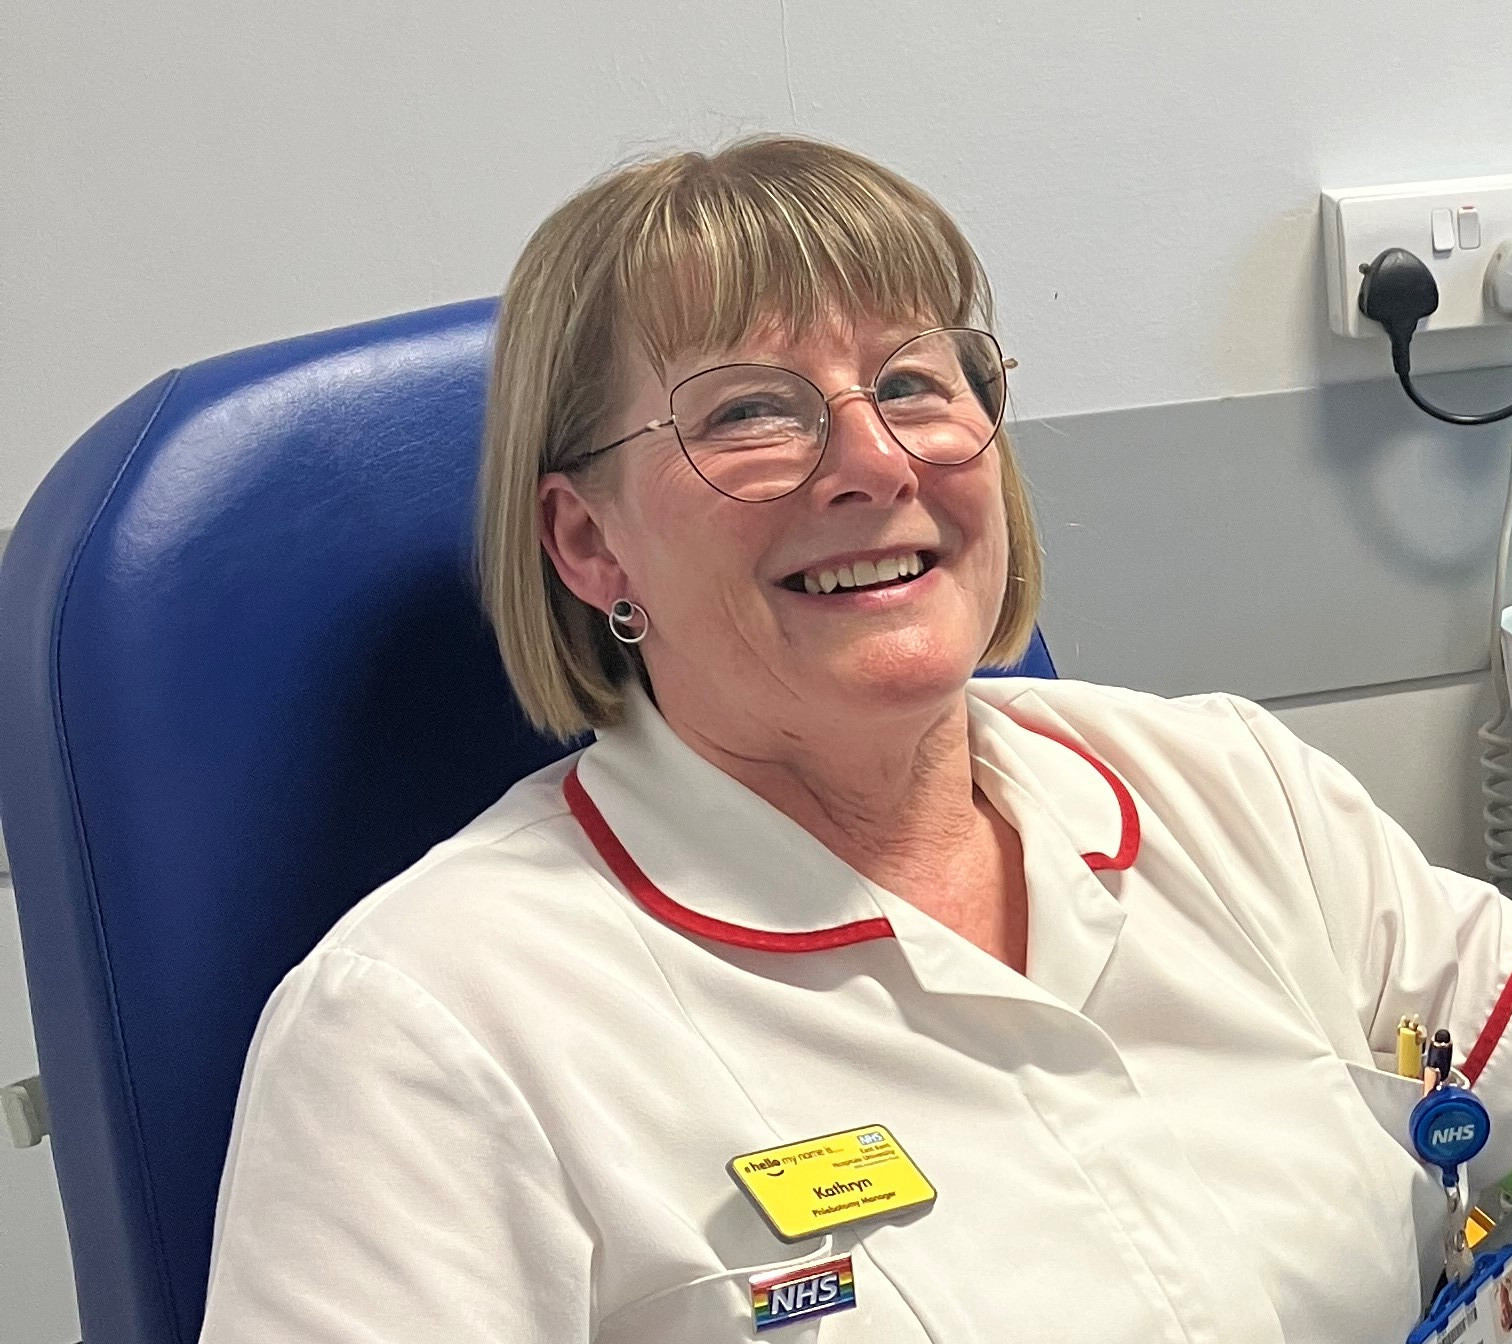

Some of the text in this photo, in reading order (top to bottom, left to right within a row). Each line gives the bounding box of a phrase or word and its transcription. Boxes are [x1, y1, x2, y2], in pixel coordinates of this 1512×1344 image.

[858, 1132, 884, 1144] NHS
[1432, 1124, 1475, 1146] NHS
[782, 1156, 798, 1165] my
[798, 1149, 824, 1161] name
[813, 1179, 873, 1199] Kathryn
[770, 1274, 838, 1315] NHS
